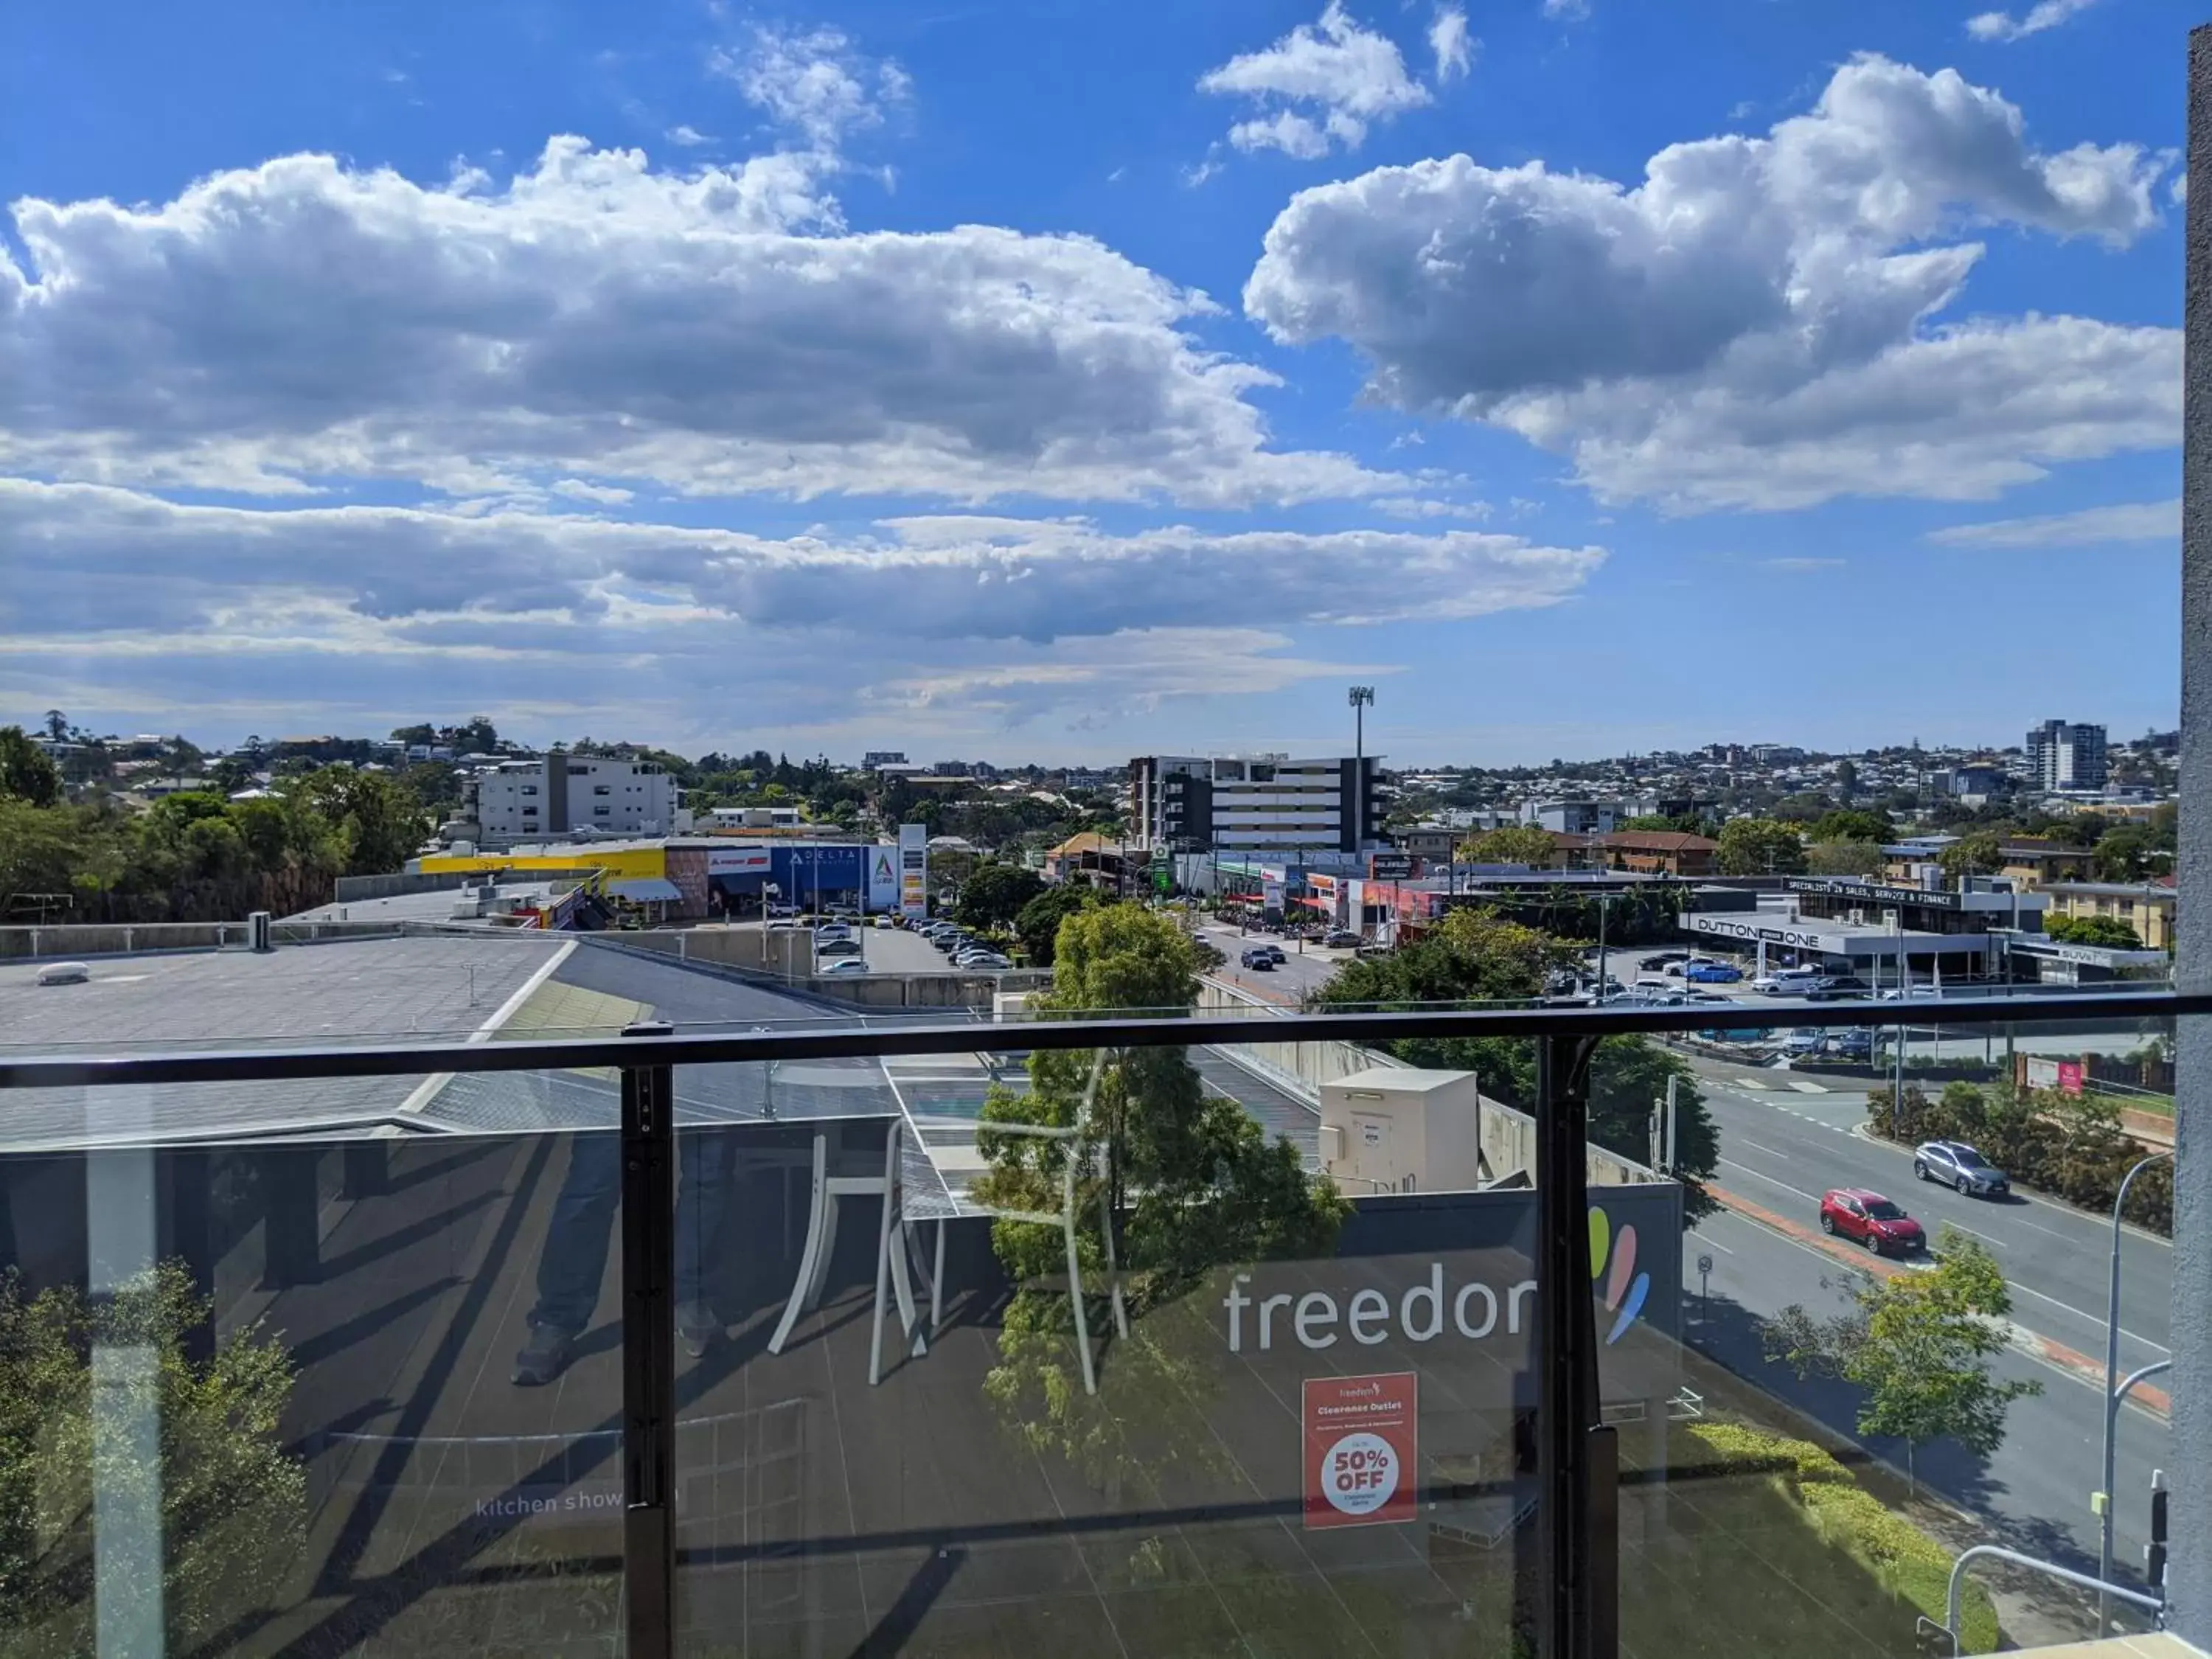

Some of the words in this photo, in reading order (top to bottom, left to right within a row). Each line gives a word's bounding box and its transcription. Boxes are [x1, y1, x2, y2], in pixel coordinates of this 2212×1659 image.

[804, 850, 855, 860] DELTA
[1788, 880, 1831, 893] SPECIALISTS
[1834, 884, 1843, 894] IN
[1875, 888, 1906, 901] SERVICE
[1909, 892, 1915, 902] &
[1918, 893, 1952, 906] FINANCE
[1698, 918, 1759, 939] DUTTON
[1784, 931, 1820, 948] ONE
[1318, 1405, 1368, 1416] Clearance
[1370, 1402, 1402, 1411] Outlet
[1335, 1449, 1389, 1472] 50%
[1336, 1470, 1384, 1491] OFF
[476, 1496, 557, 1517] kitchen
